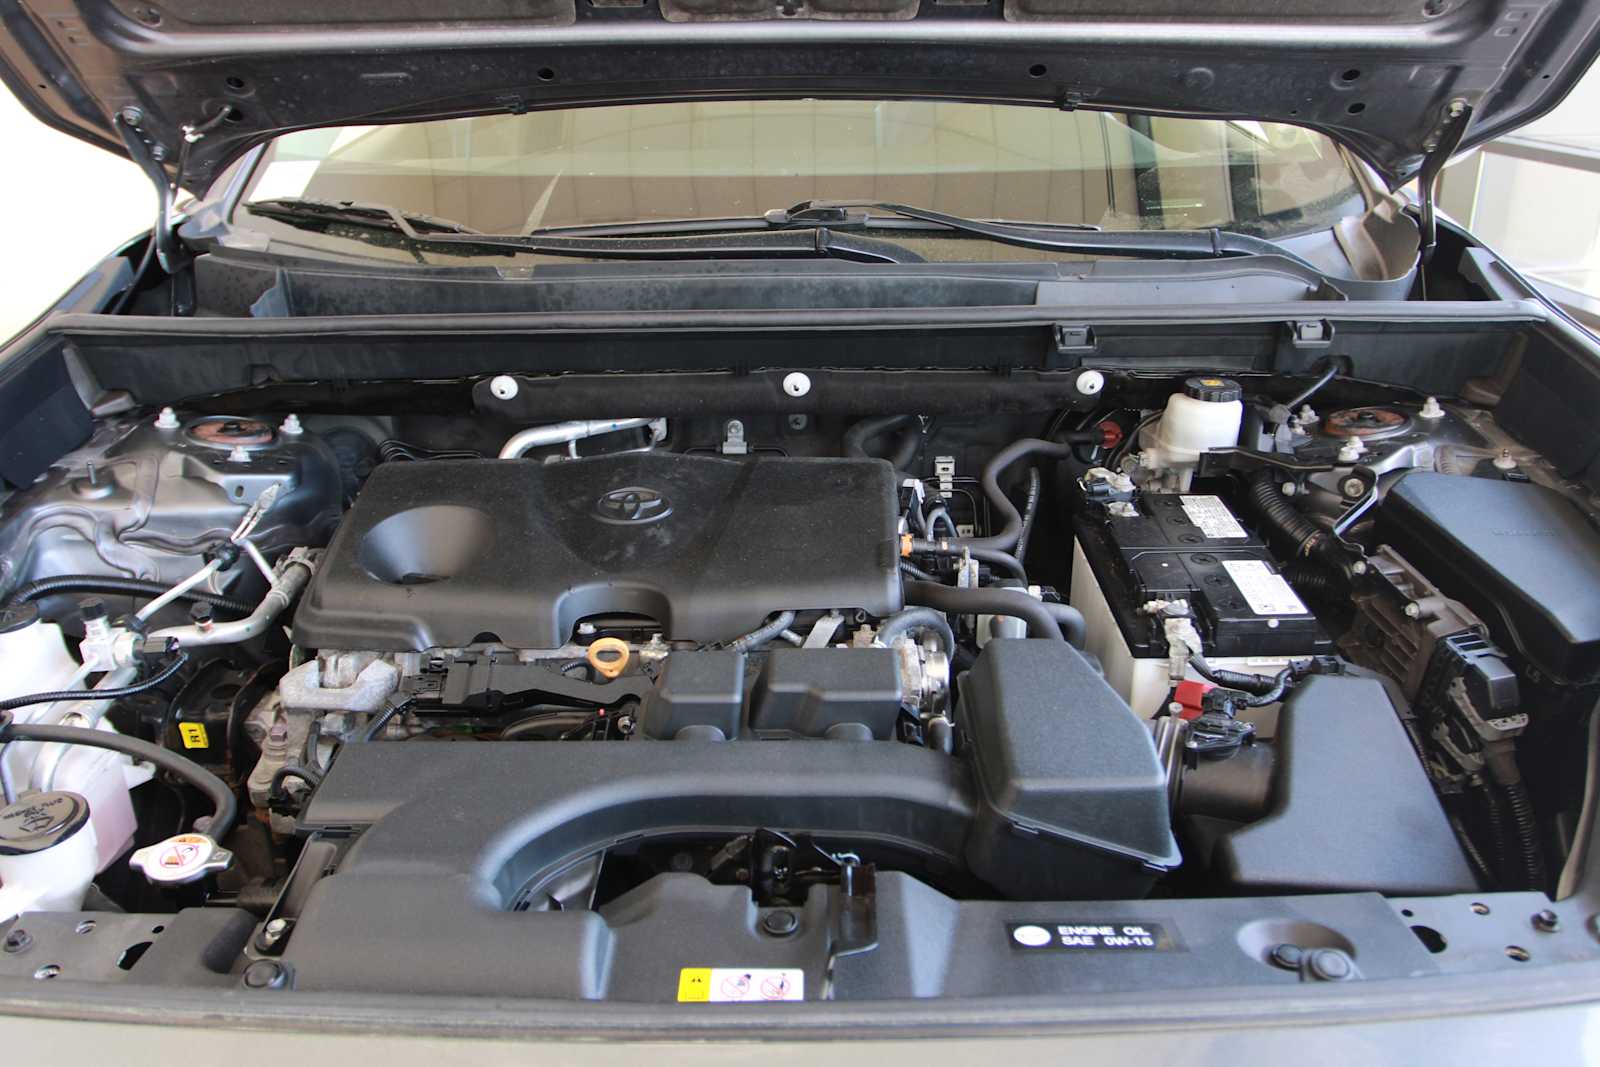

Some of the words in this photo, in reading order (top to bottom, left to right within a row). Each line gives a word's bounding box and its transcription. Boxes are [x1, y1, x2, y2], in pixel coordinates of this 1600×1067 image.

[1057, 925, 1115, 936] ENGINE
[1122, 926, 1151, 936] OIL
[1061, 936, 1096, 946] SAE
